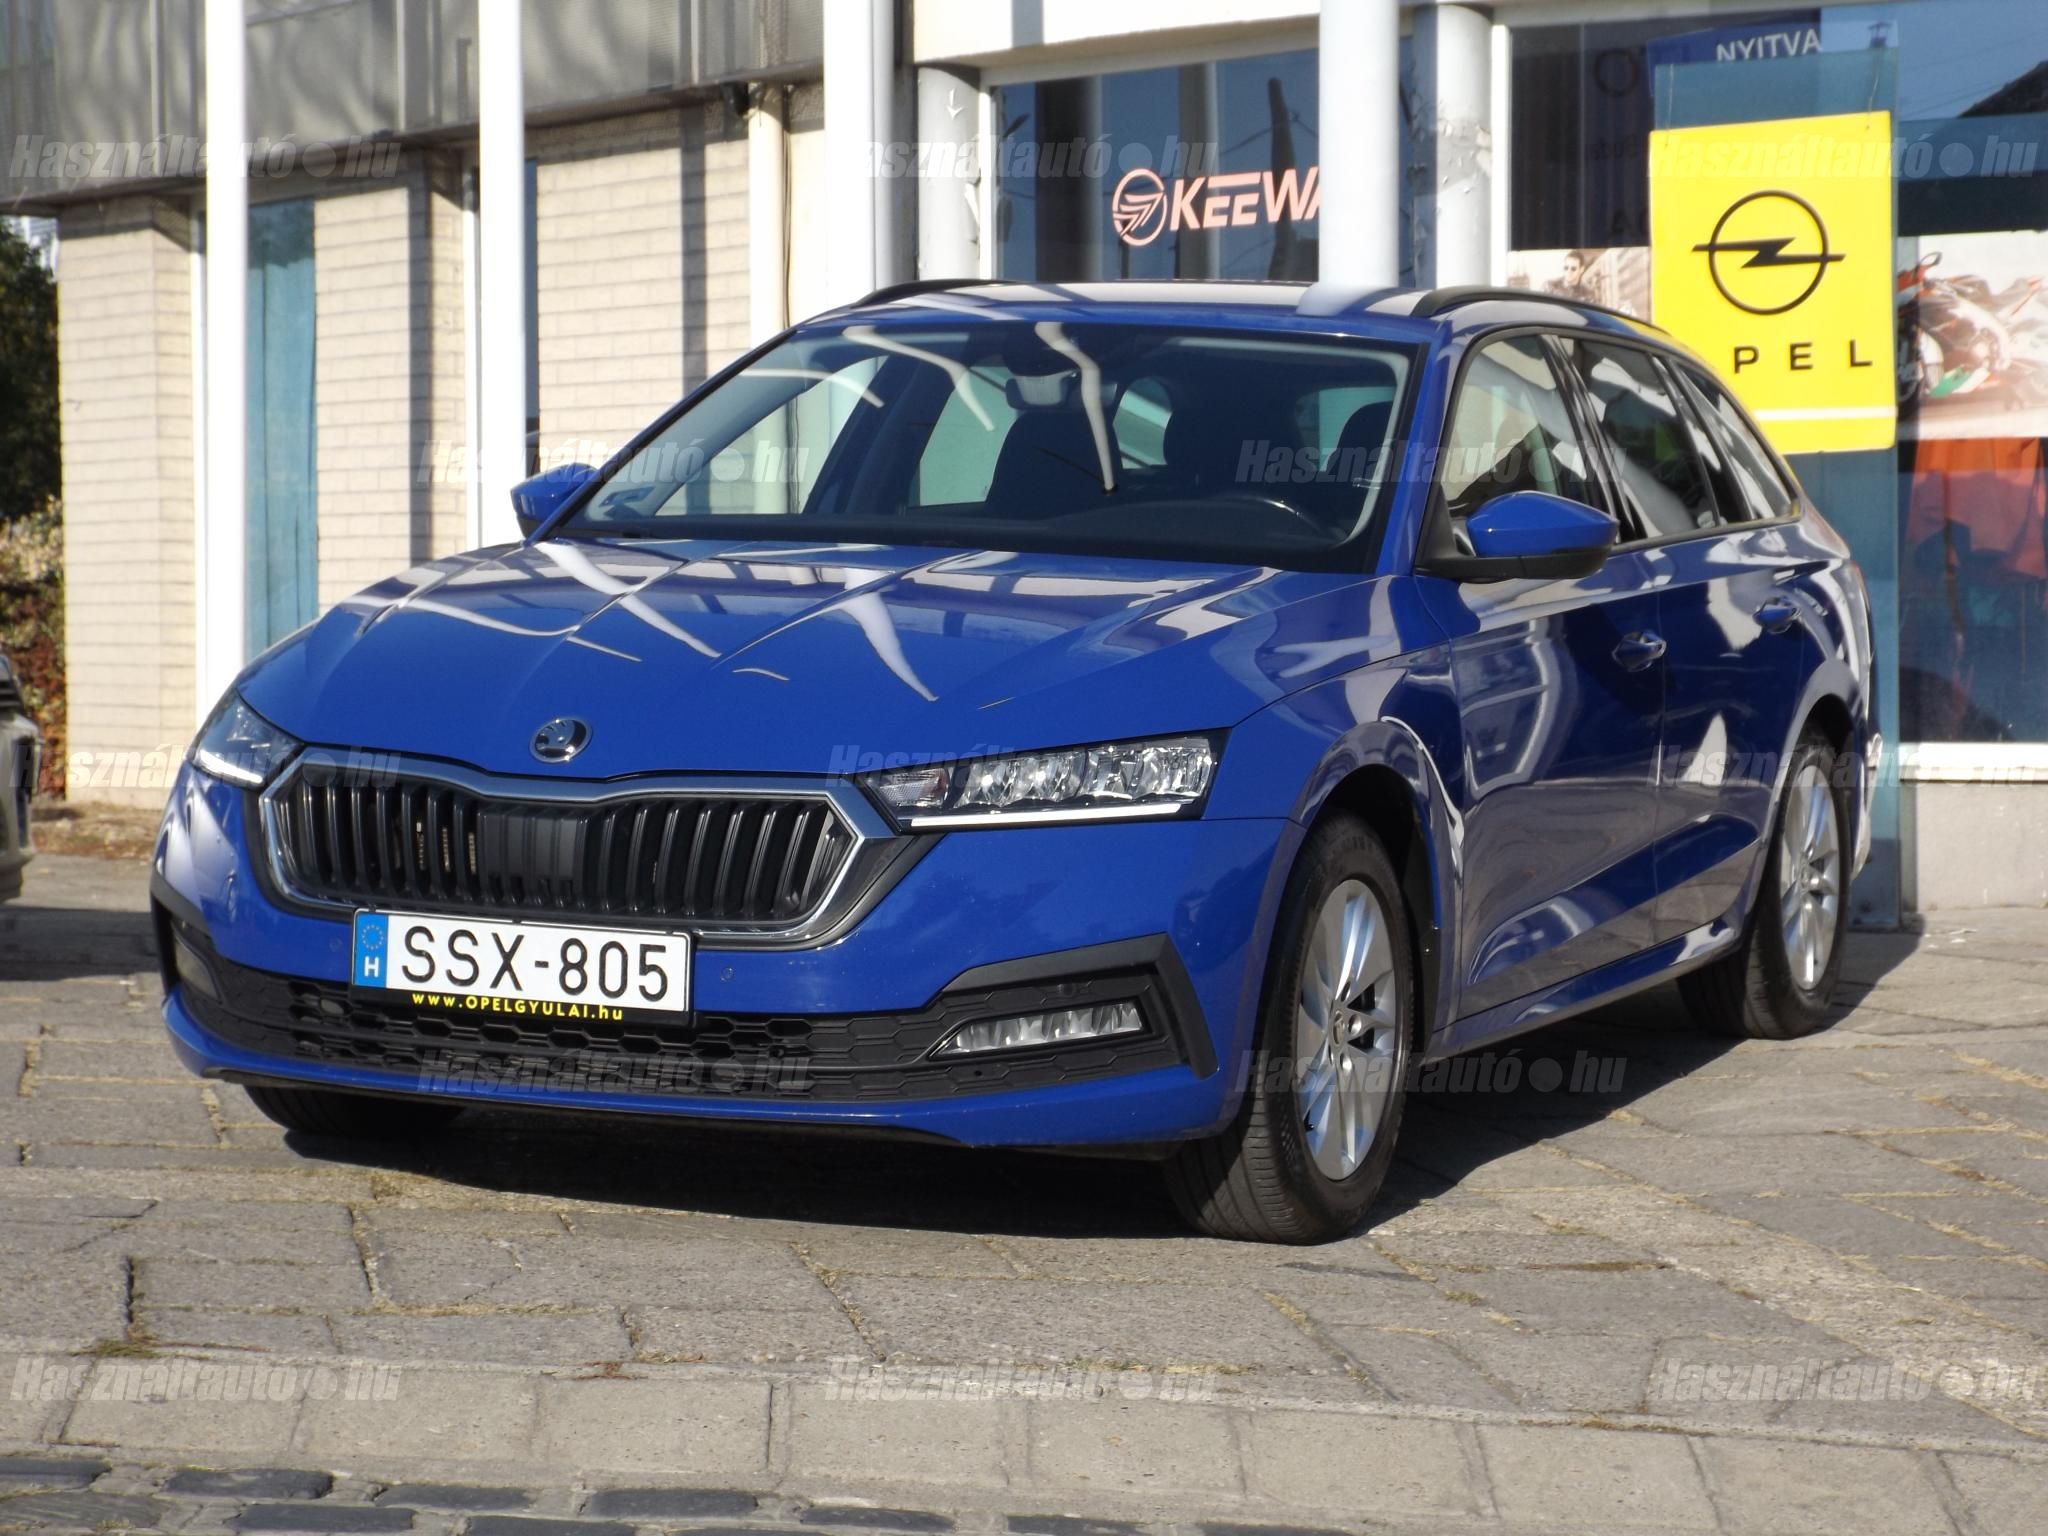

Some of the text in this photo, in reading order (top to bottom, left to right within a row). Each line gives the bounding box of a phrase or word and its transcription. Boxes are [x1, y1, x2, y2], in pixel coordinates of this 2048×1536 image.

[1716, 28, 1823, 62] NYITVA
[1169, 166, 1319, 231] KEEW
[1733, 340, 1873, 374] PEL
[364, 957, 380, 978] H
[402, 925, 669, 1002] SSX-805
[412, 993, 623, 1021] www.OPELGYULAI.hu
